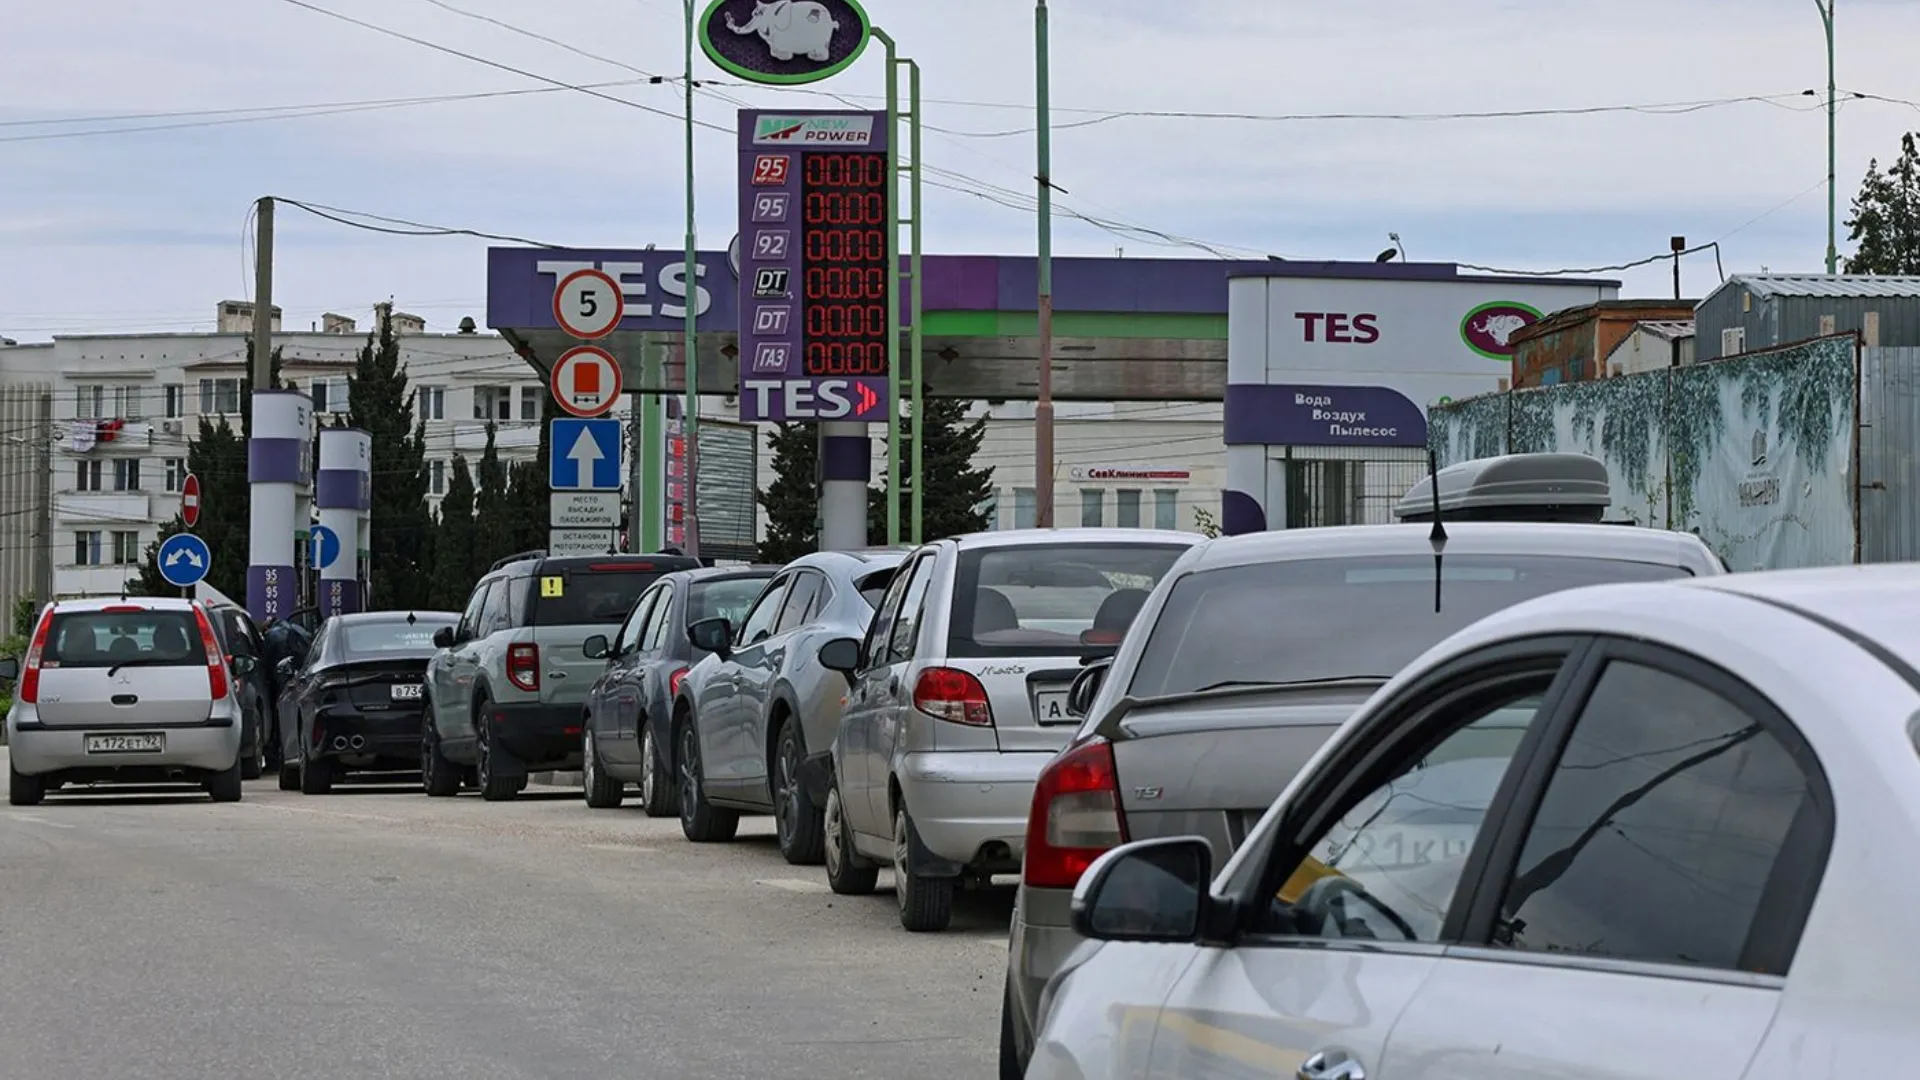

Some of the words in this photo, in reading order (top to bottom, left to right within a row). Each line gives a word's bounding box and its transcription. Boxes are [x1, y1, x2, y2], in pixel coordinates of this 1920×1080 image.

[807, 119, 849, 130] NEW
[804, 130, 868, 142] POWER
[759, 158, 784, 177] 95
[758, 198, 784, 217] 95
[759, 235, 785, 254] 92
[758, 270, 786, 289] DT
[580, 290, 598, 317] 5
[757, 311, 787, 330] DT
[1294, 312, 1380, 344] TES
[759, 347, 786, 367] ГАЗ
[744, 380, 852, 418] TES
[1295, 393, 1332, 407] Вода
[1312, 409, 1366, 423] Воздух
[1329, 424, 1398, 437] Пылесос
[573, 496, 599, 504] МЕСТО
[568, 506, 605, 514] ВЫСАДКИ
[560, 516, 612, 524] ПАССАЖИРОВ
[562, 533, 608, 541] ОСТАНОВКА
[265, 569, 278, 582] 95
[265, 585, 279, 598] 95
[265, 601, 278, 613] 92
